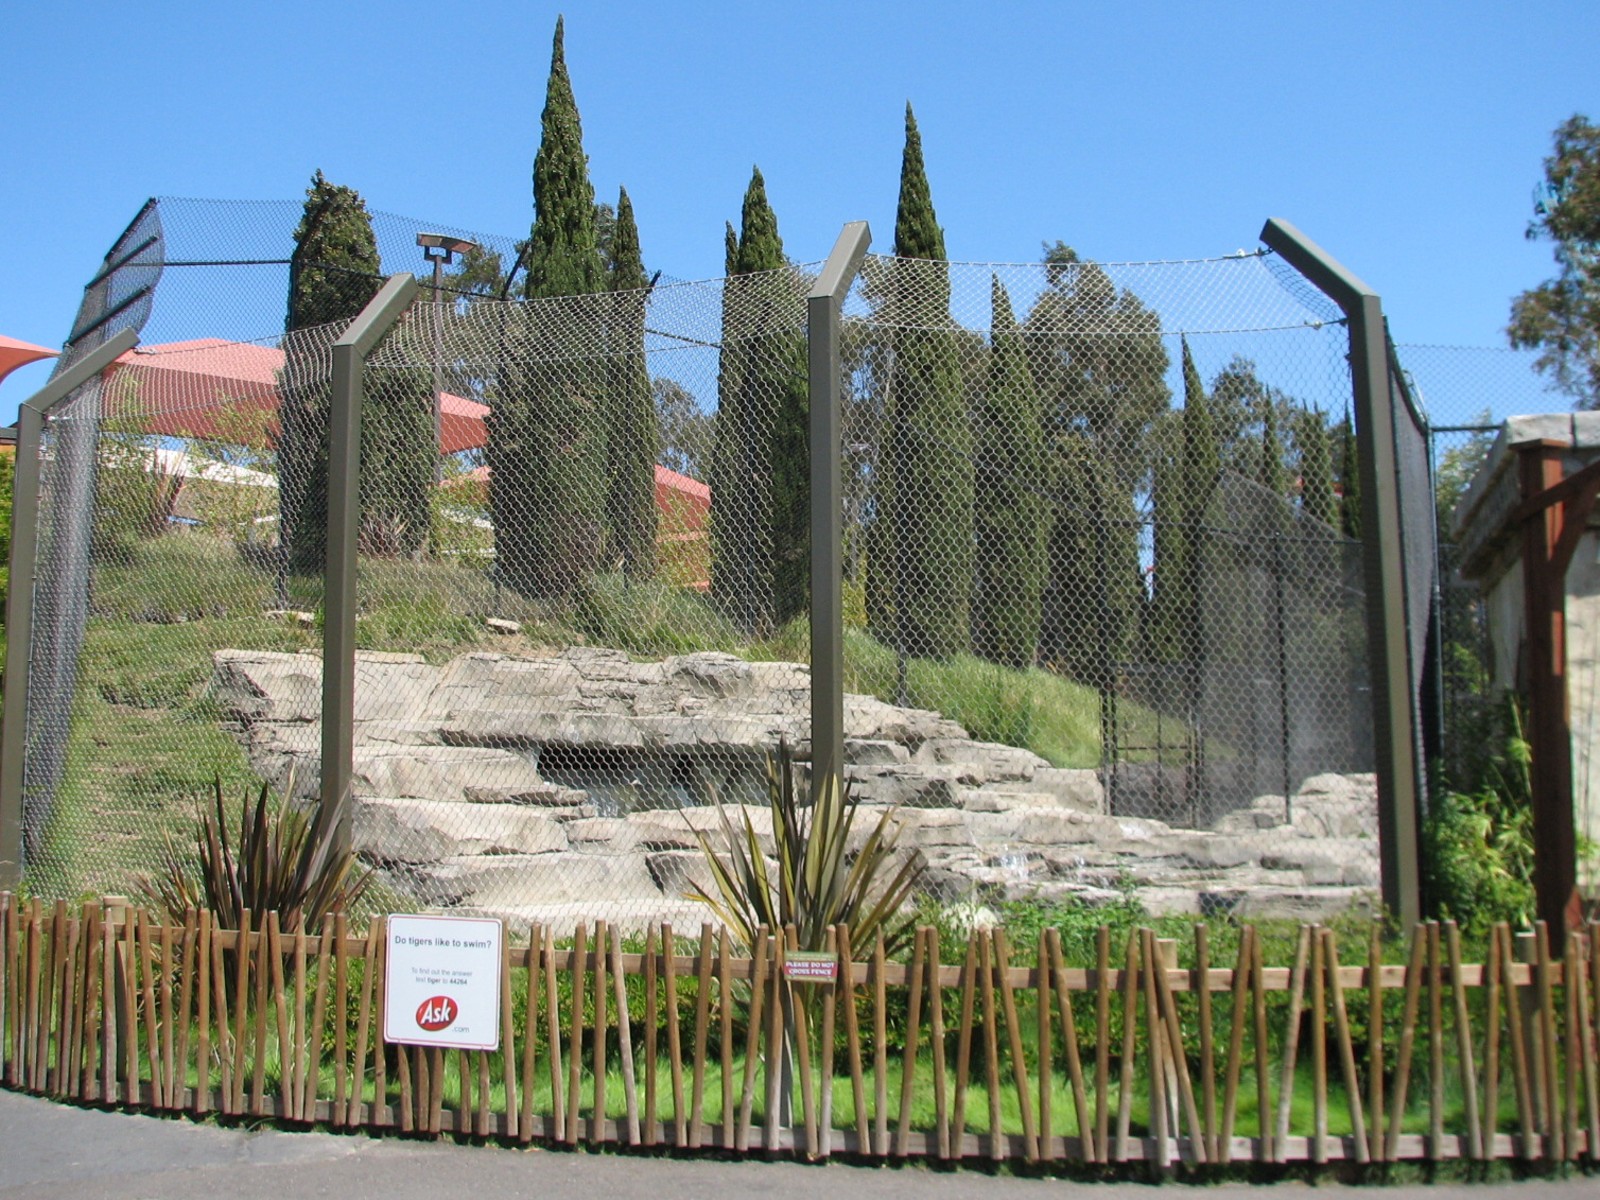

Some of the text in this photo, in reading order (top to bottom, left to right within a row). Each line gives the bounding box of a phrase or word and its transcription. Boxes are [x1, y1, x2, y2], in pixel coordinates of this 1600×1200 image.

[395, 935, 492, 949] Do tigers like to swim?
[441, 968, 451, 976] the
[427, 977, 441, 985] tiger
[420, 998, 451, 1024] Ask
